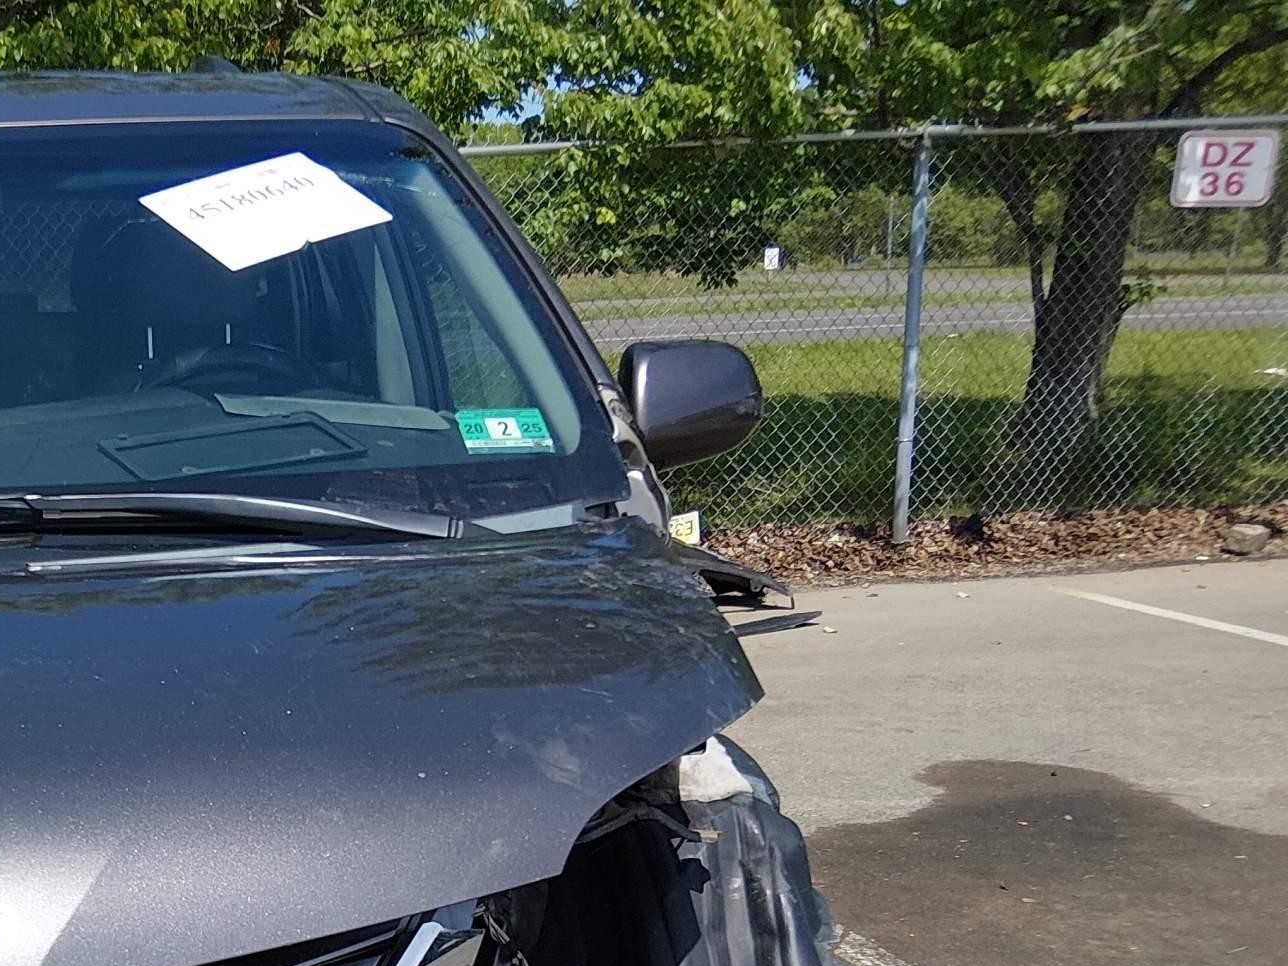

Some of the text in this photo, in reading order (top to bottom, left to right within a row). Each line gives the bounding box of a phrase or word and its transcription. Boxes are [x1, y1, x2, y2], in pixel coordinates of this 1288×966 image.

[1200, 141, 1257, 168] DZ
[1199, 171, 1246, 197] 36
[187, 175, 316, 222] 45180640
[463, 421, 543, 437] 20 2 25
[669, 518, 693, 537] E3
